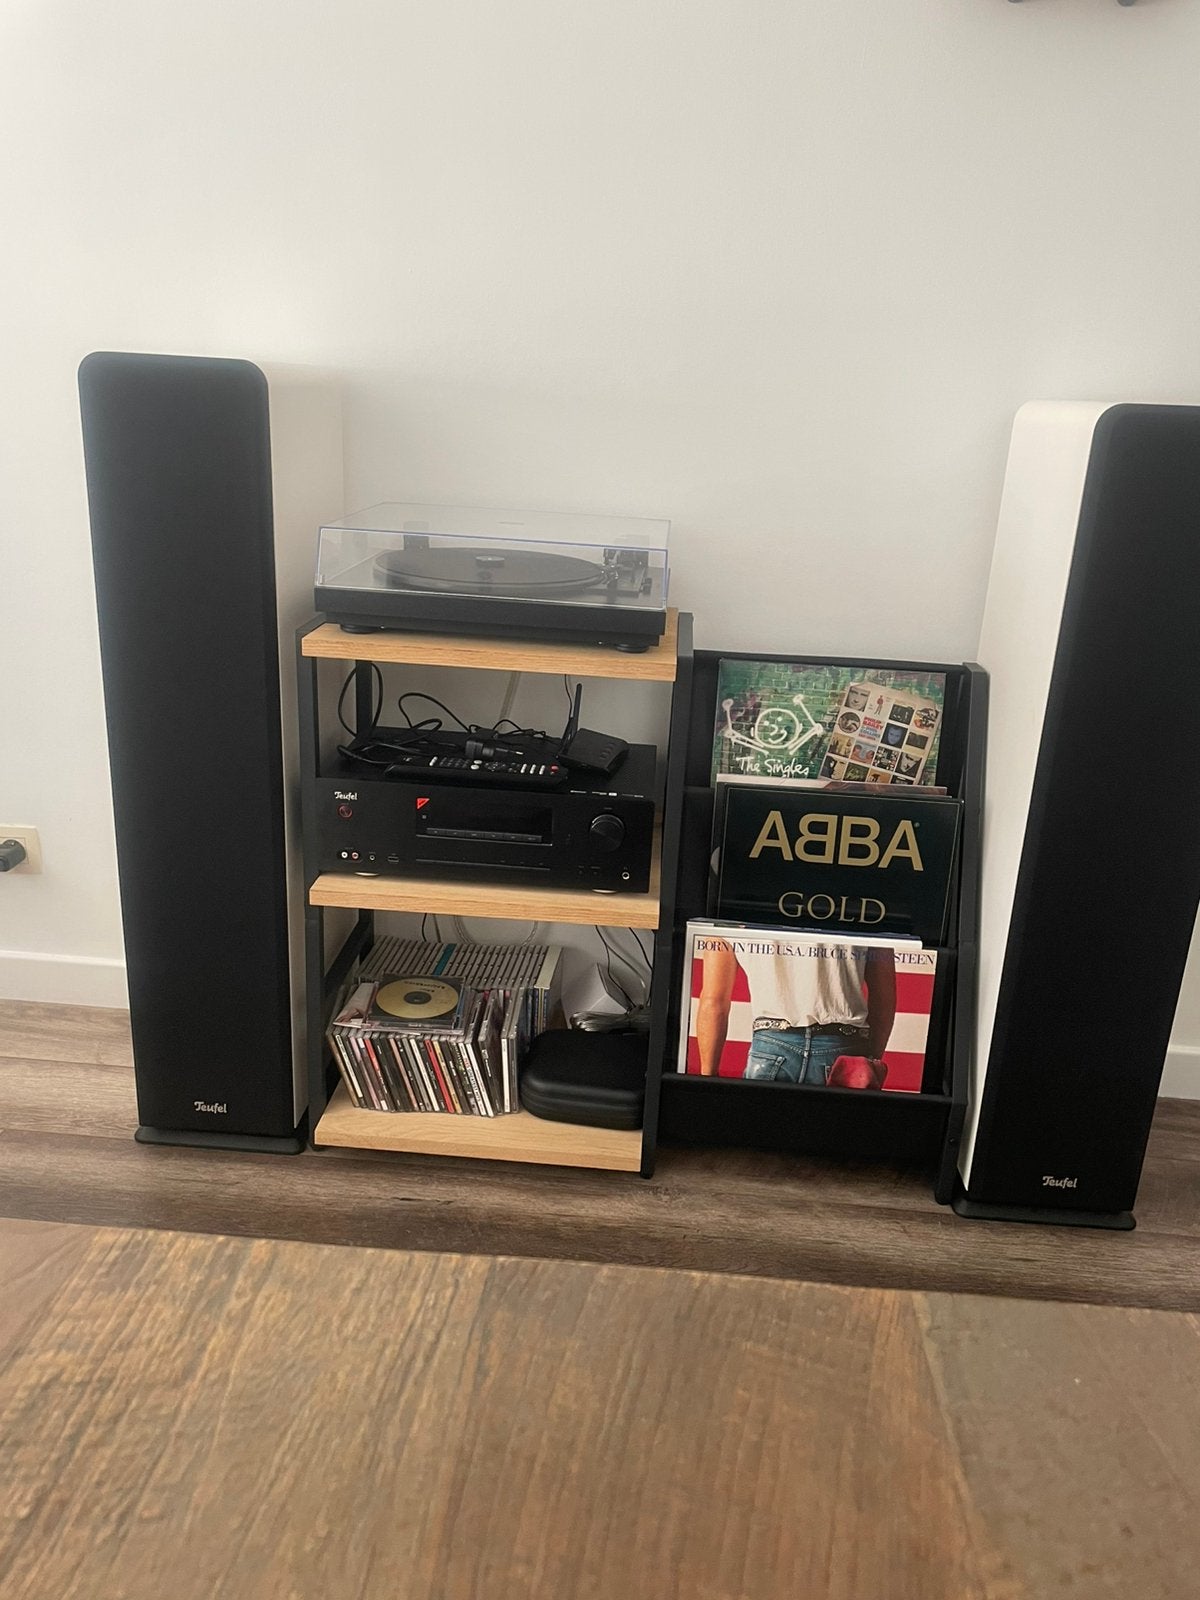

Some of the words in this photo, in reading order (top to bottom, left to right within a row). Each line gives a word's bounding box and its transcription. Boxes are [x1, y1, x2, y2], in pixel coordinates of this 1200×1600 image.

[735, 756, 760, 773] The
[764, 757, 809, 778] Singles
[334, 791, 358, 801] Teufel
[749, 810, 924, 872] ABBA
[778, 891, 886, 924] GOLD
[697, 940, 730, 953] BORN
[731, 941, 746, 953] IN
[747, 942, 775, 956] THE
[808, 946, 848, 960] BRUCE
[850, 948, 935, 965] SPRISTEEN
[193, 1101, 228, 1114] Teufel
[1042, 1176, 1078, 1189] Teufel
